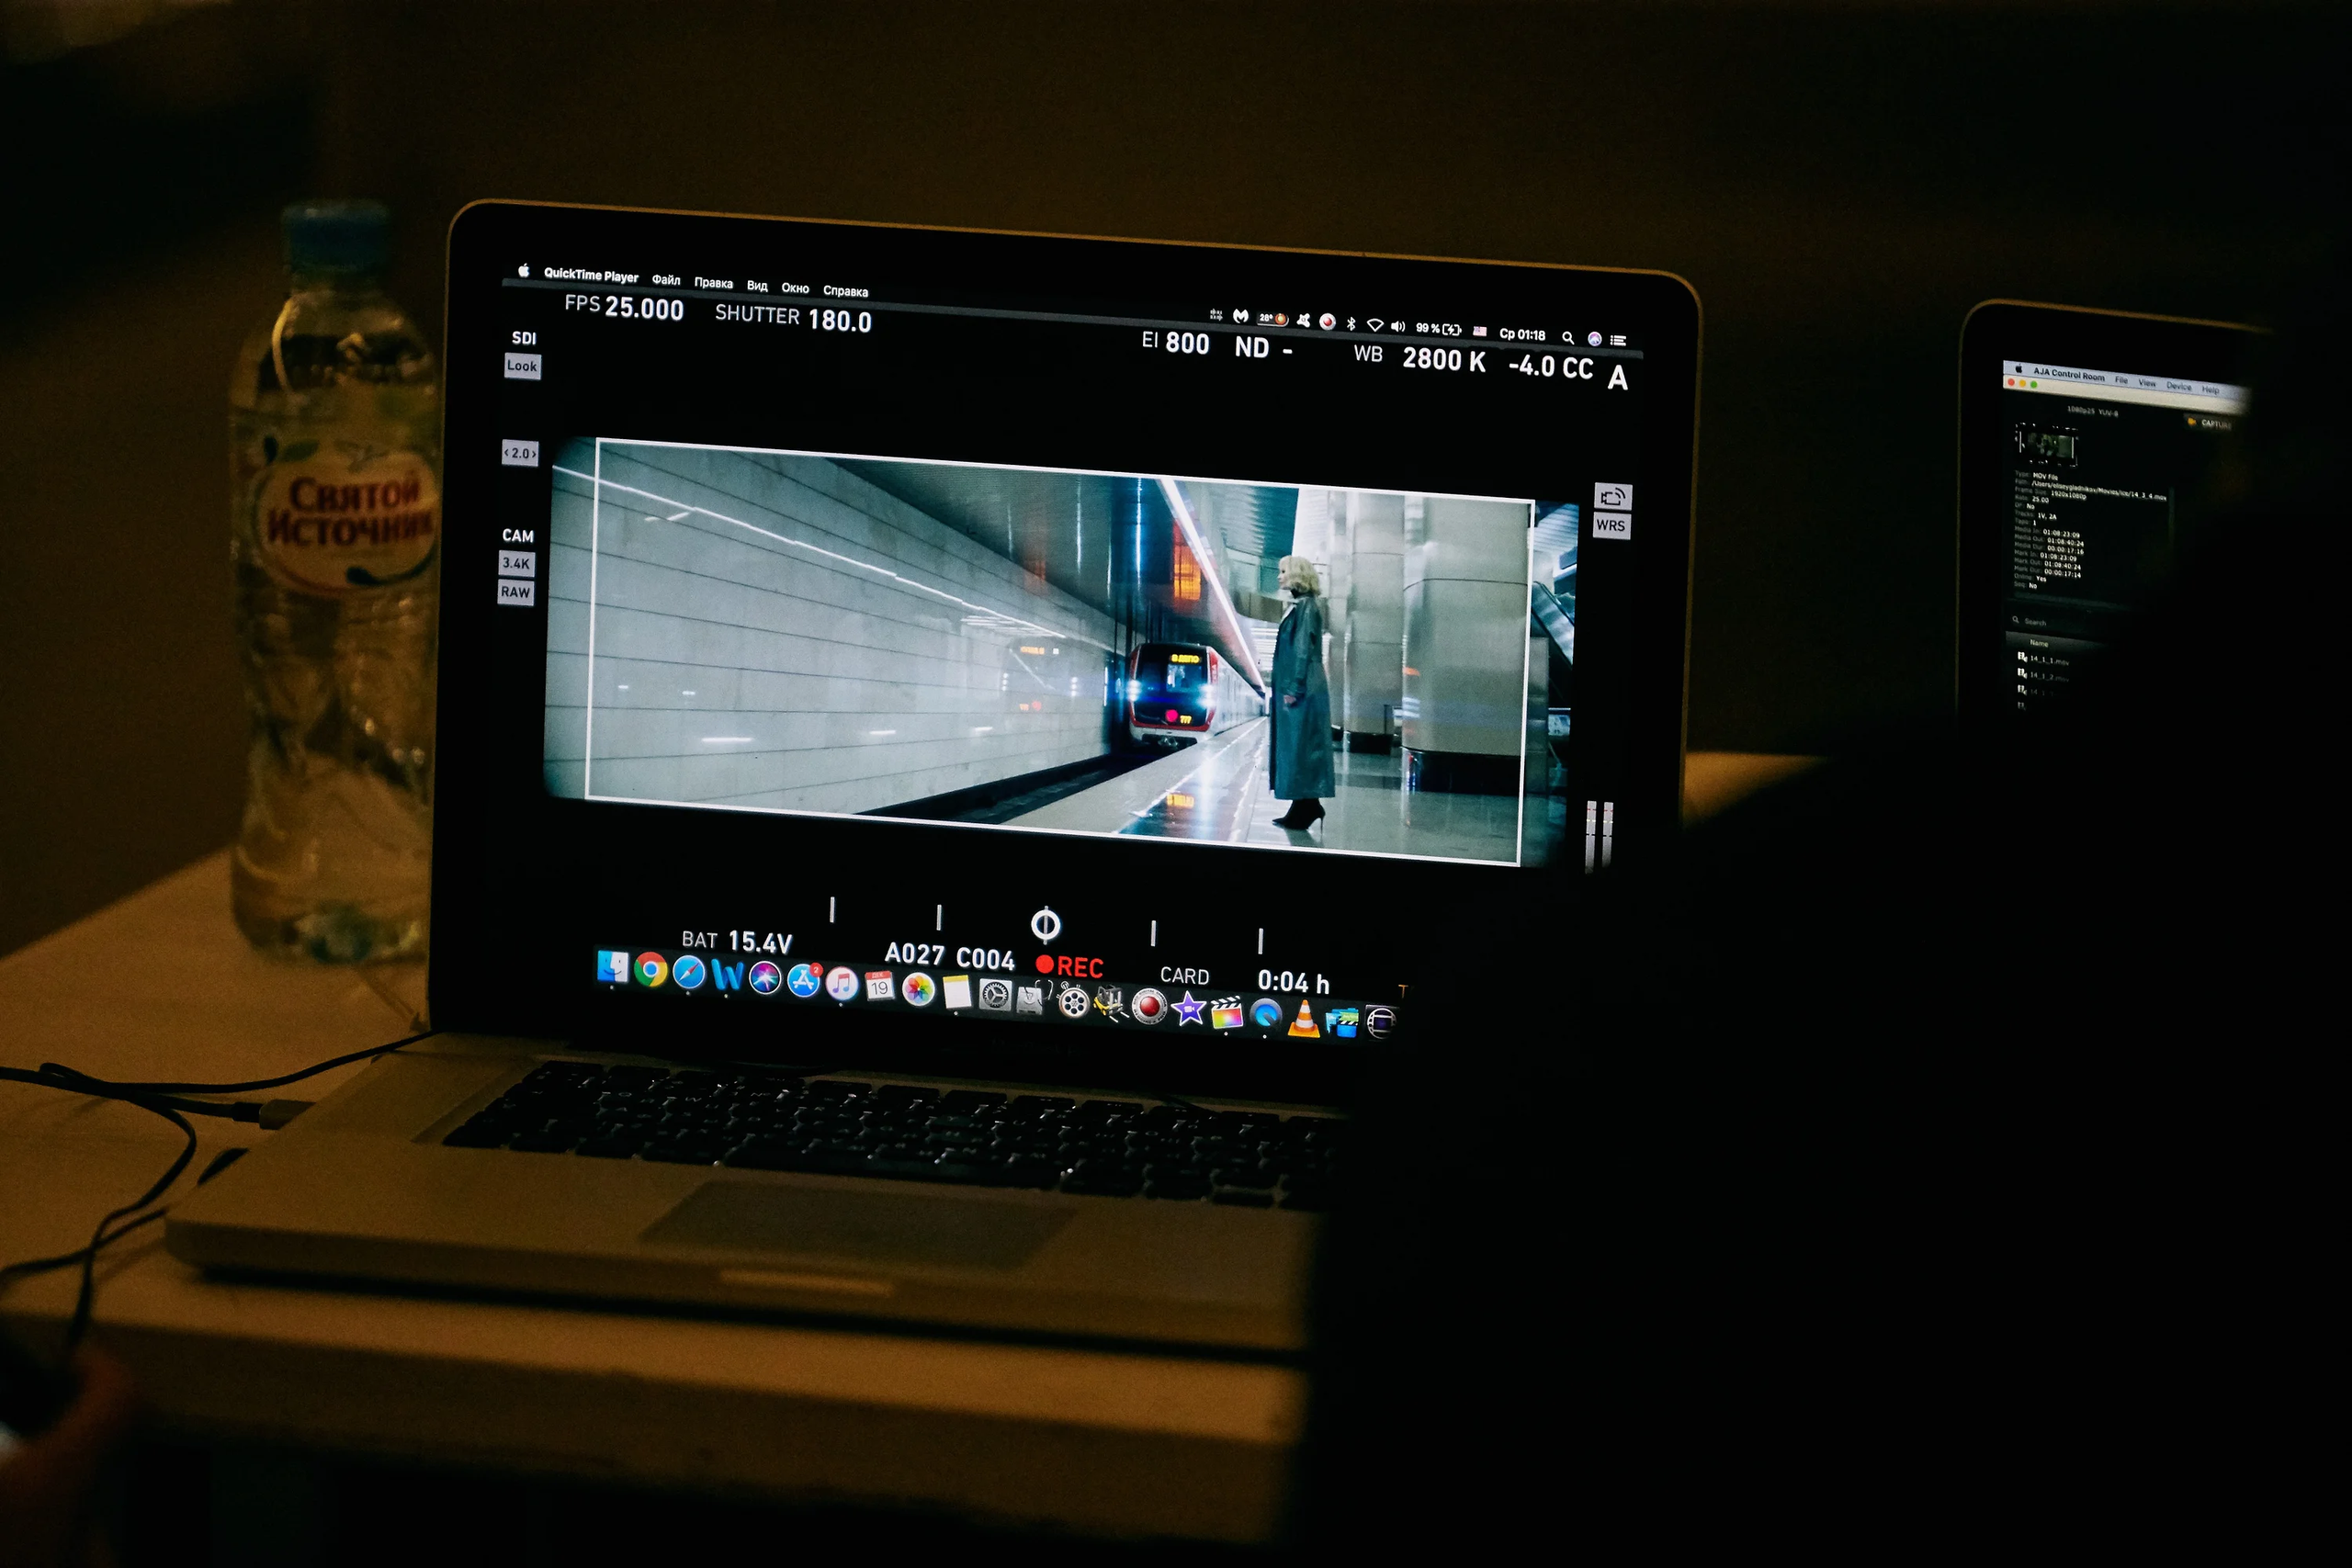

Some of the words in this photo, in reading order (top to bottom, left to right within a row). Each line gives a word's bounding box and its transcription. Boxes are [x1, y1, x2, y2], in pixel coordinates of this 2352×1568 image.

[544, 267, 602, 282] QuickTime
[605, 271, 639, 285] Player
[652, 274, 682, 287] Файл
[695, 276, 734, 289] Правка
[747, 279, 769, 293] Вид
[782, 282, 810, 294] Окно
[823, 285, 869, 299] Справка
[565, 294, 601, 313] FPS
[605, 295, 684, 321] 25.000
[715, 303, 800, 325] SHUTTER
[809, 308, 872, 333] 180.0
[1416, 322, 1430, 333] 99
[1499, 327, 1516, 341] Ср
[1517, 329, 1546, 342] 01:18
[512, 331, 537, 345] SDI
[1142, 331, 1159, 349] EI
[1165, 332, 1211, 355] 800
[1235, 335, 1270, 359] ND
[507, 359, 537, 373] Look
[1353, 344, 1384, 363] WB
[1403, 346, 1463, 372] 2800
[1469, 351, 1487, 374] K
[1509, 354, 1555, 378] -4.0
[1563, 357, 1595, 380] CC
[2033, 367, 2050, 377] AJA
[2052, 368, 2081, 379] Control
[2083, 372, 2106, 382] Room
[1607, 365, 1629, 391] A
[2115, 376, 2129, 385] File
[2139, 378, 2156, 388] View
[2166, 381, 2192, 392] Device
[2202, 385, 2220, 395] Help
[1596, 517, 1625, 534] WRS
[503, 528, 534, 543] CAM
[503, 558, 530, 570] 3.4K
[501, 585, 531, 599] RAW
[2024, 616, 2047, 626] Search
[2030, 638, 2048, 648] Name
[682, 931, 718, 949] BAT
[729, 930, 794, 954] 15.4V
[885, 941, 945, 966] A027
[956, 946, 1015, 972] C004
[1057, 955, 1103, 979] REC
[1160, 965, 1210, 986] CARD
[1258, 969, 1309, 994] 0:04
[1317, 974, 1330, 995] h
[871, 981, 888, 996] 19
